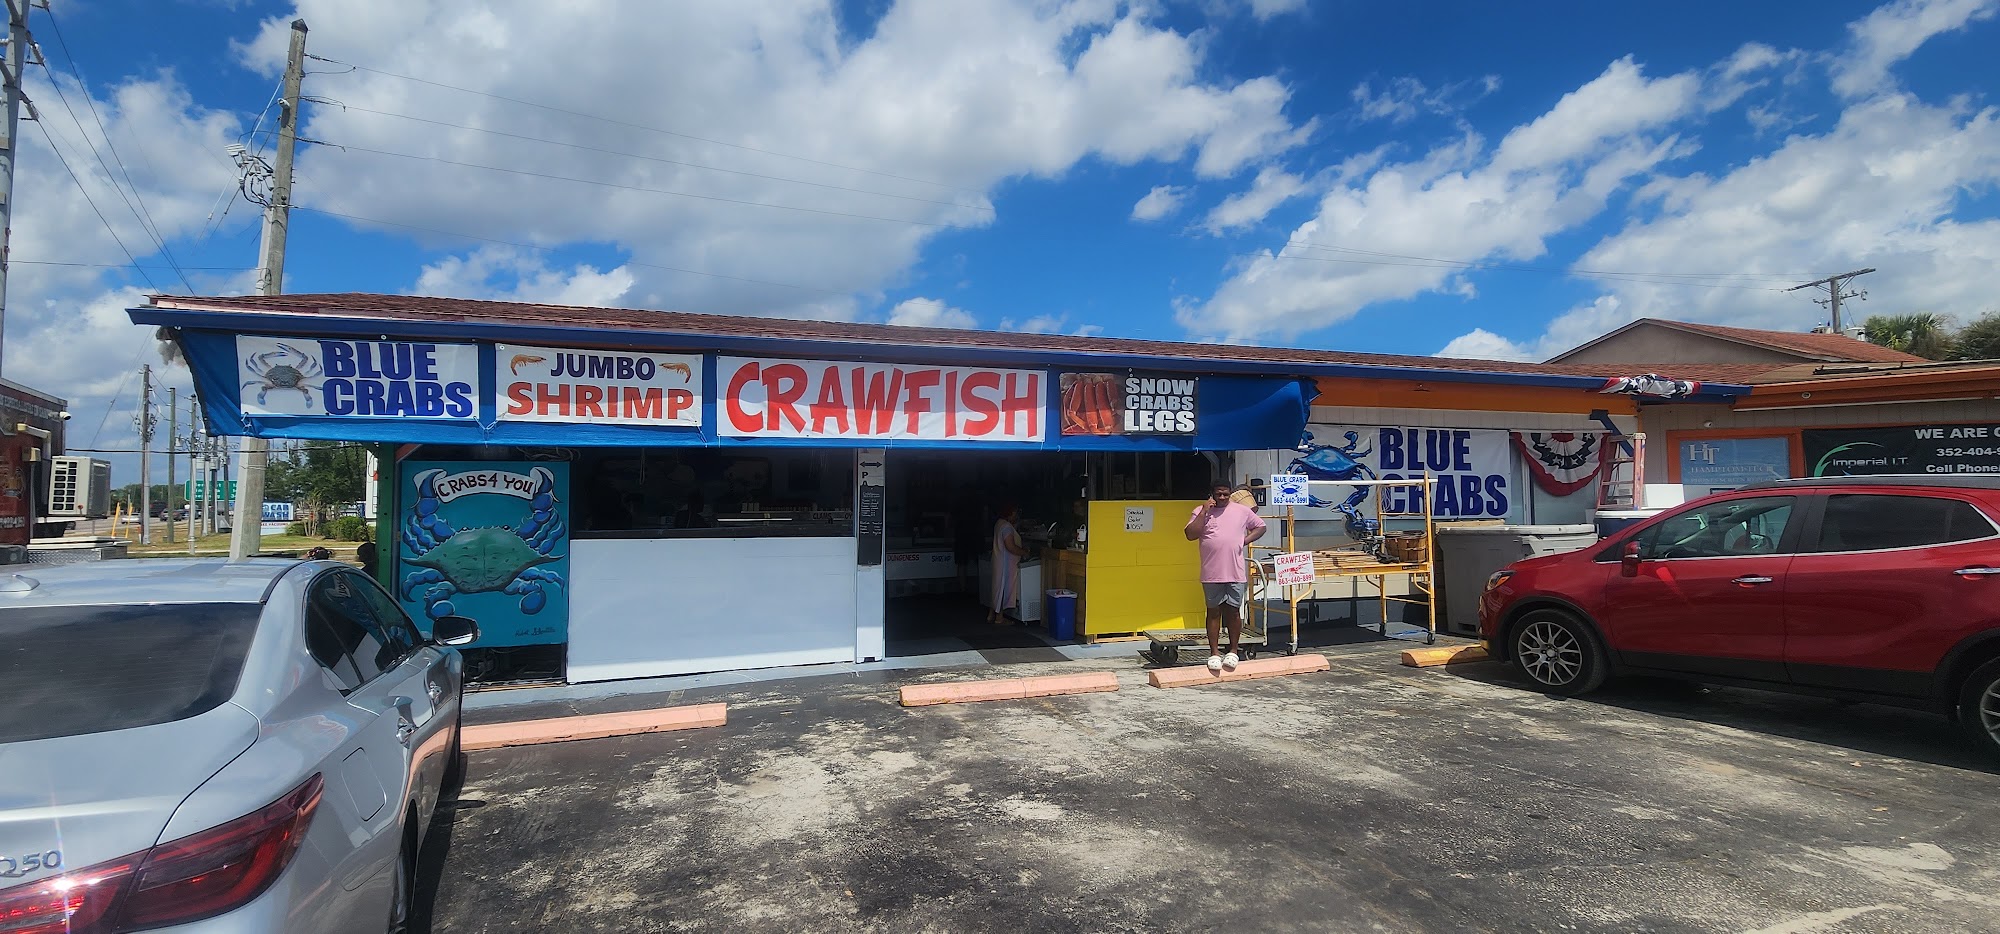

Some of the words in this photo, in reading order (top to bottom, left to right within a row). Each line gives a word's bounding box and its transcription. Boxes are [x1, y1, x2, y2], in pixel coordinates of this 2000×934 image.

[320, 340, 439, 381] BLUE
[550, 353, 656, 380] JUMBO
[323, 378, 473, 418] CRABS
[1125, 377, 1195, 395] SNOW
[507, 382, 694, 420] SHRIMP
[726, 361, 1038, 438] CRAWFISH
[1125, 395, 1194, 411] CRABS
[1124, 410, 1195, 432] LEGS
[1914, 429, 1945, 440] WE
[1949, 428, 1988, 439] ARE
[1379, 428, 1472, 471] BLUE
[1832, 457, 1888, 469] Imperial
[1926, 464, 1953, 473] Cell
[503, 474, 535, 495] YOU
[1381, 473, 1508, 517] CRABS
[1276, 554, 1311, 565] CRAWFISH
[0, 850, 62, 878] Q50
